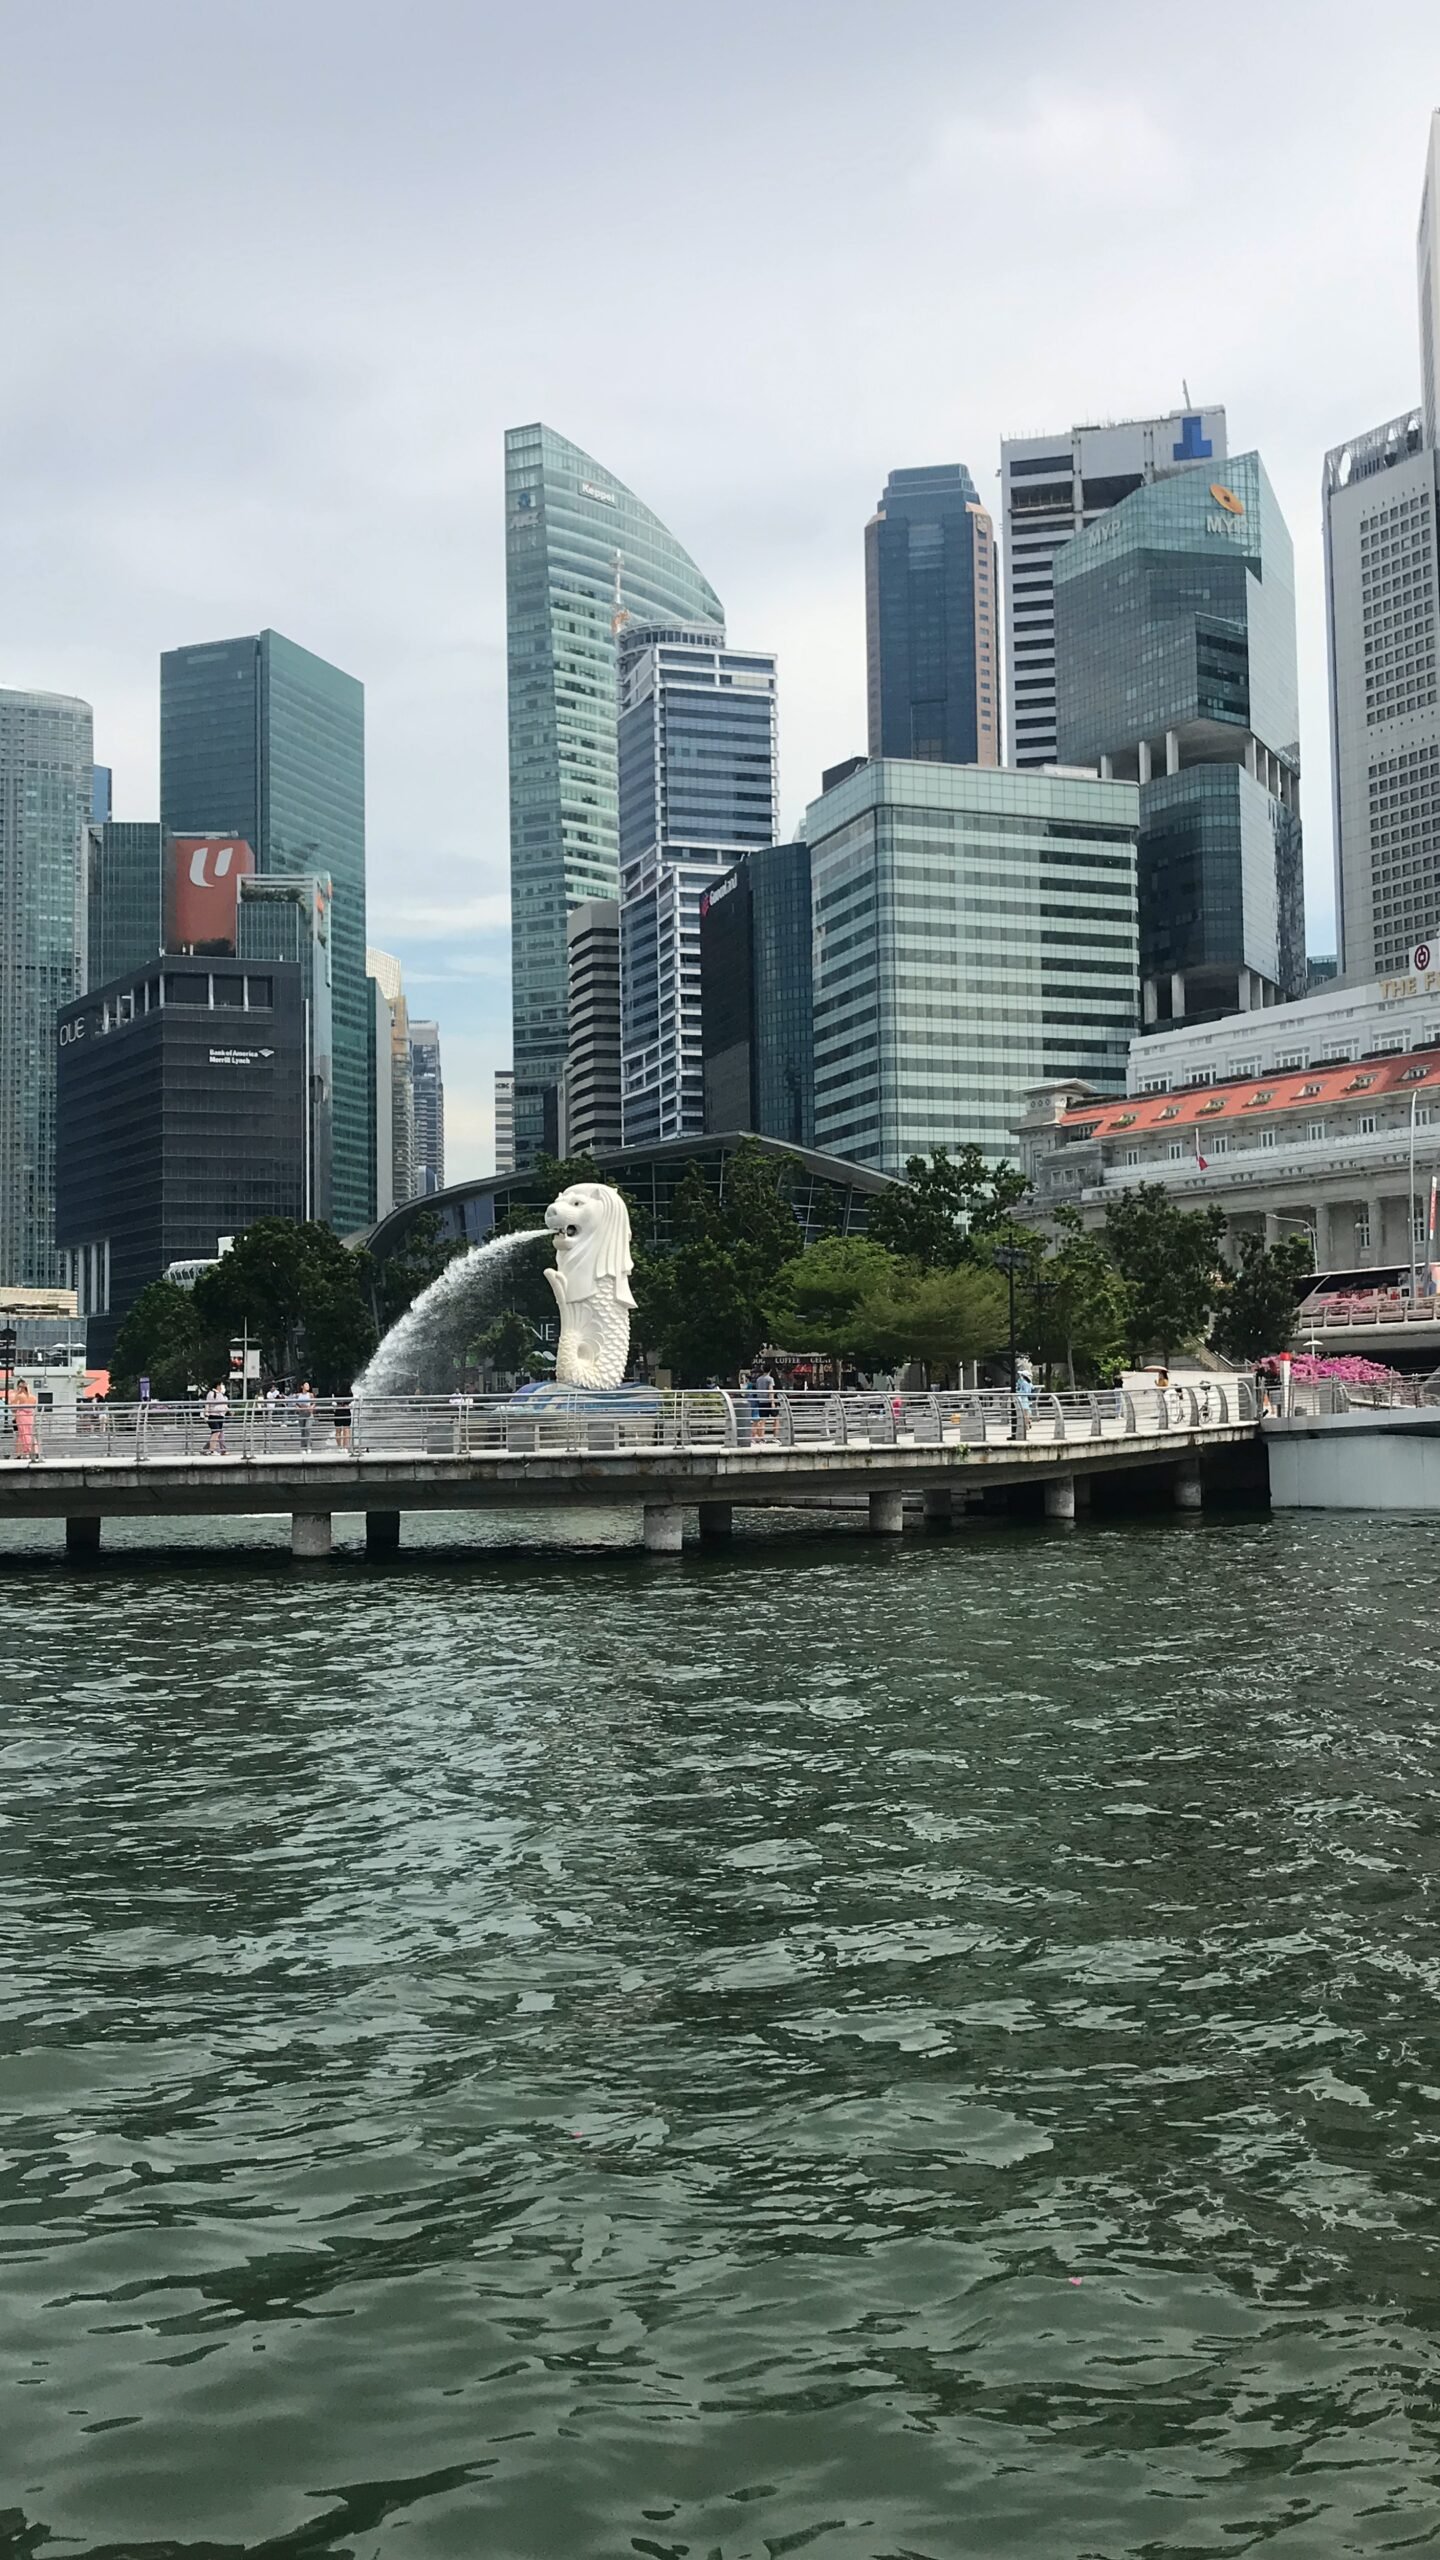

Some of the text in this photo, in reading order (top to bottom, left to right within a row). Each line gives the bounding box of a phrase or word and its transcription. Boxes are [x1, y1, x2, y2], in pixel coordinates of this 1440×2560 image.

[582, 483, 615, 503] Keppel
[1089, 519, 1121, 547] MYP
[1206, 514, 1247, 535] MYP
[1380, 971, 1440, 1000] THE F
[60, 1017, 85, 1046] OUE
[209, 1048, 225, 1056] Bank
[233, 1049, 259, 1057] America
[522, 1323, 555, 1341] NE
